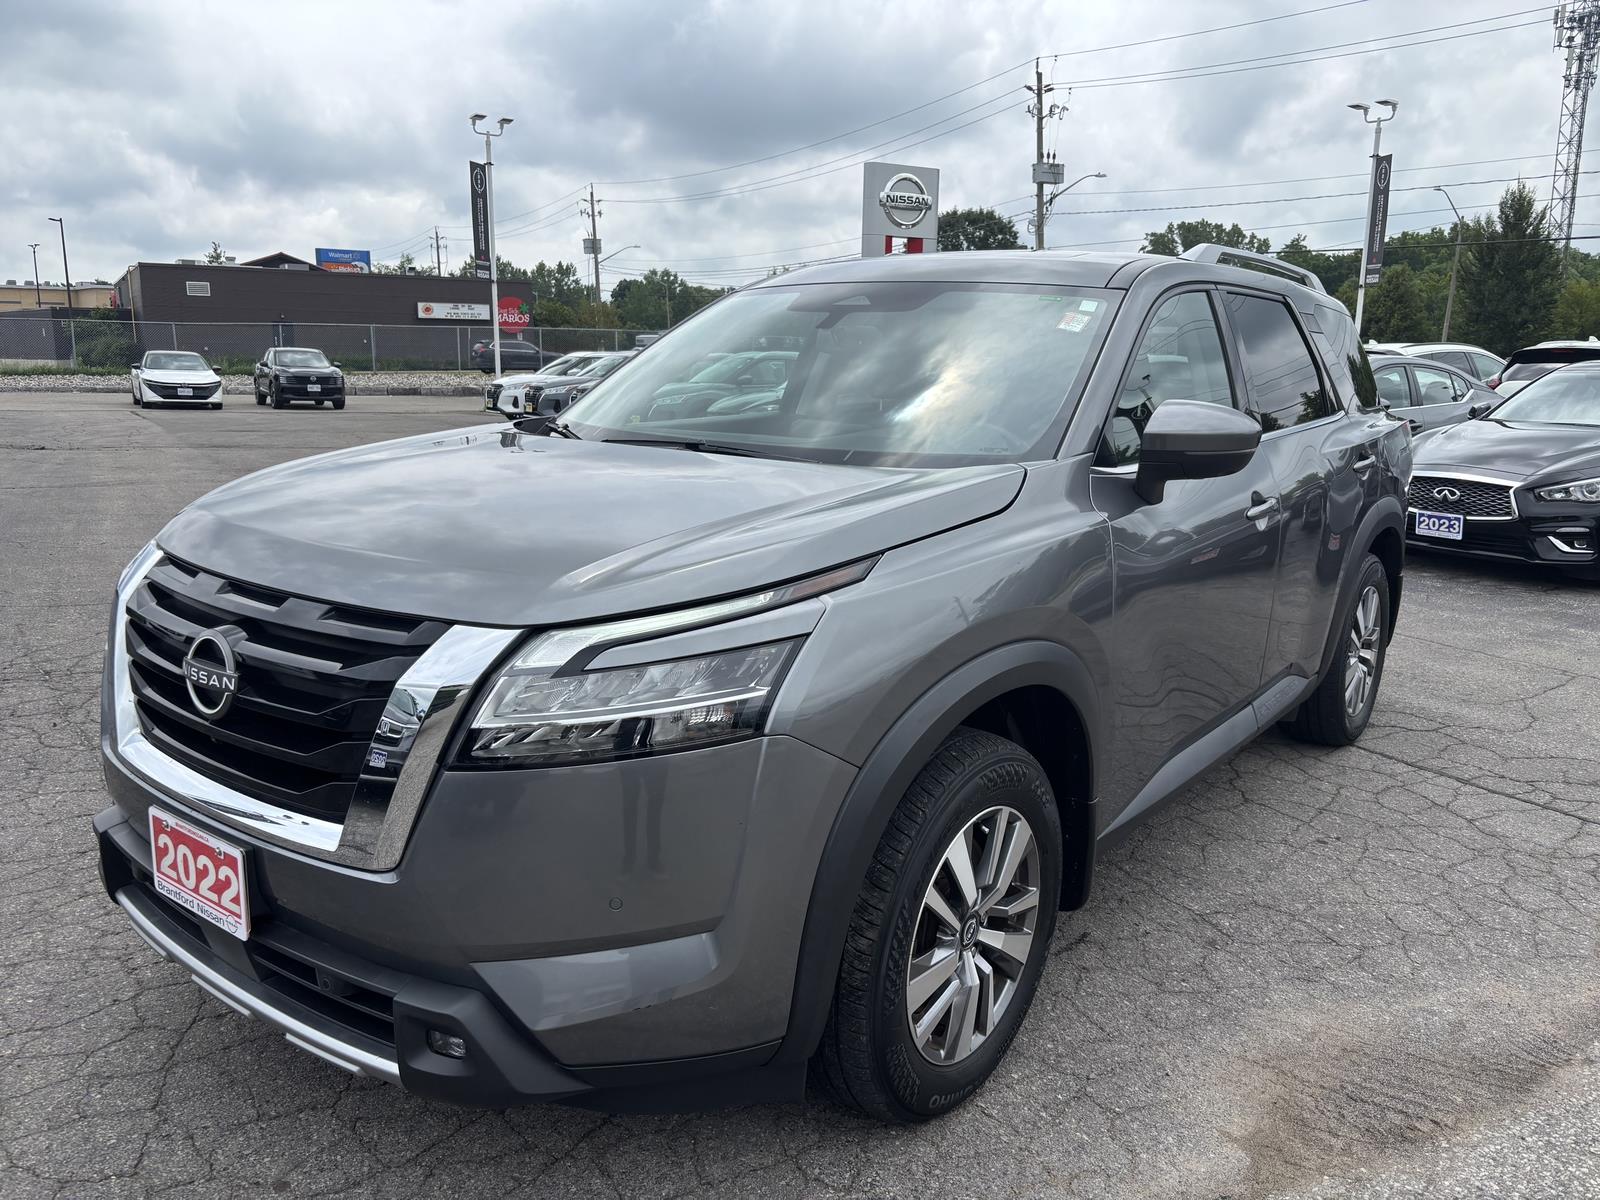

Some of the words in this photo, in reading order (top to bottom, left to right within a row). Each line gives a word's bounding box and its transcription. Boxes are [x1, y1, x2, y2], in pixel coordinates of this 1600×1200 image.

[886, 194, 929, 206] NISSAN
[1419, 516, 1460, 533] 2023
[158, 833, 241, 913] 2022
[157, 880, 194, 908] Brantford
[197, 902, 225, 926] Nissan
